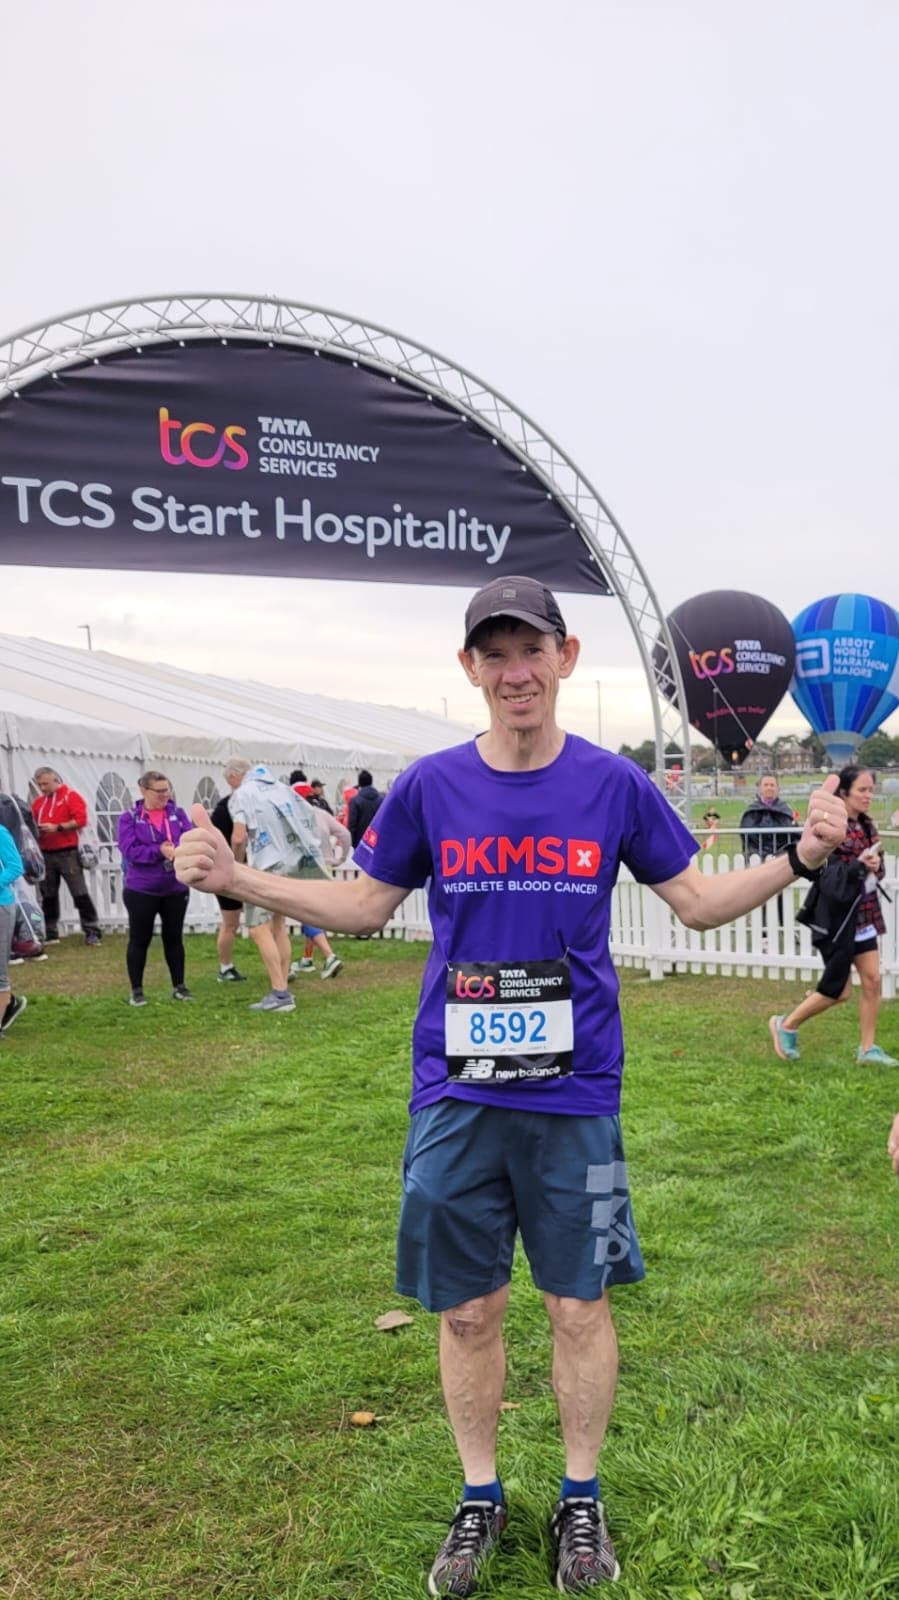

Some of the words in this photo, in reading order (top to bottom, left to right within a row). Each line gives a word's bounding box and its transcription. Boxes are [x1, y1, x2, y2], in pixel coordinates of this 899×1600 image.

[258, 416, 312, 437] TATA
[159, 407, 248, 470] tcs
[258, 436, 380, 464] CONSULTANCY
[259, 456, 338, 478] SERVICES
[1, 476, 115, 529] TCS
[131, 486, 261, 538] Start
[275, 496, 512, 565] Hospitality
[734, 640, 761, 651] TATA
[833, 637, 875, 650] ABBOTT
[833, 647, 870, 657] WORLD
[688, 648, 735, 679] tcs
[833, 656, 889, 672] MARATHON
[833, 666, 873, 678] MAJORS
[440, 836, 565, 878] DKMS
[508, 880, 551, 892] BLOOD
[554, 881, 598, 895] CANCER
[499, 969, 527, 978] TATA
[455, 970, 496, 999] tcs
[499, 976, 563, 989] CONSULTANCY
[499, 988, 541, 998] SERVICES
[469, 1010, 547, 1045] 8592
[495, 1069, 518, 1079] new
[518, 1066, 561, 1078] balance
